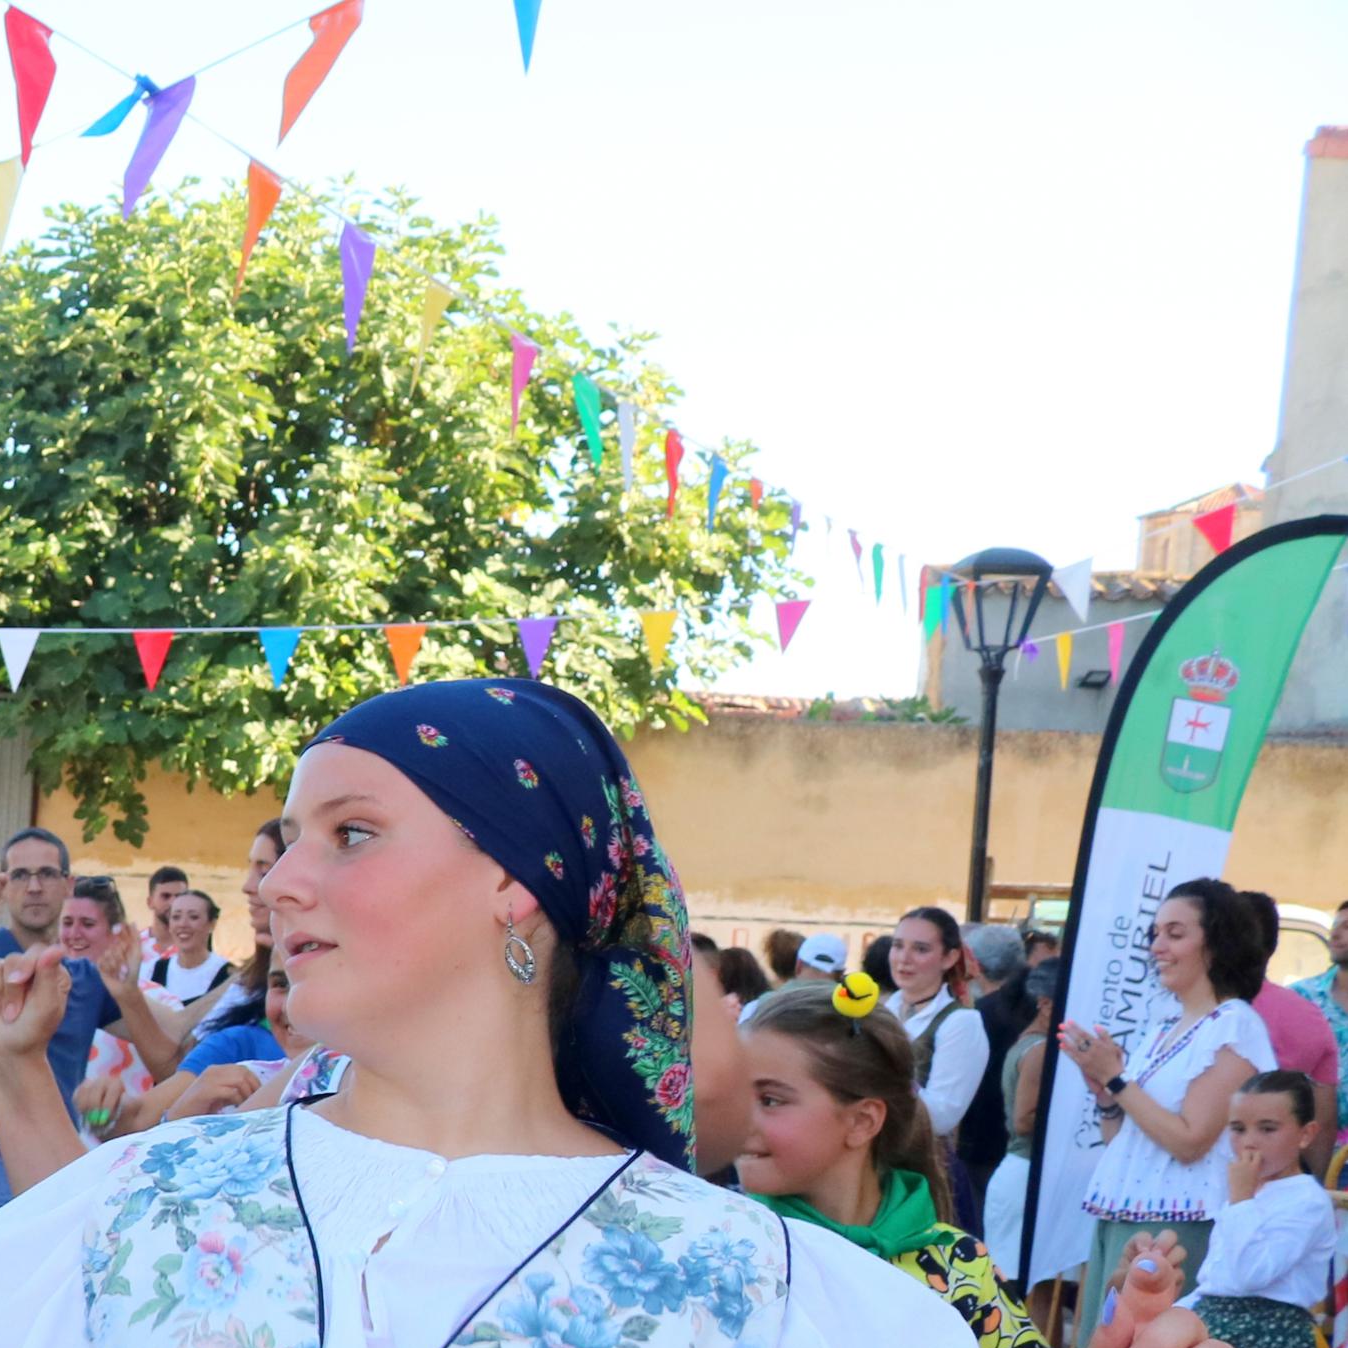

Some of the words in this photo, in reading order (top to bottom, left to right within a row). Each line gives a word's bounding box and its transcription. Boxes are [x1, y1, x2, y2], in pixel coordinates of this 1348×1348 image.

[1075, 959, 1124, 1149] Ayuiento
[1107, 915, 1132, 950] de
[1088, 850, 1172, 1149] VAMURIEL
